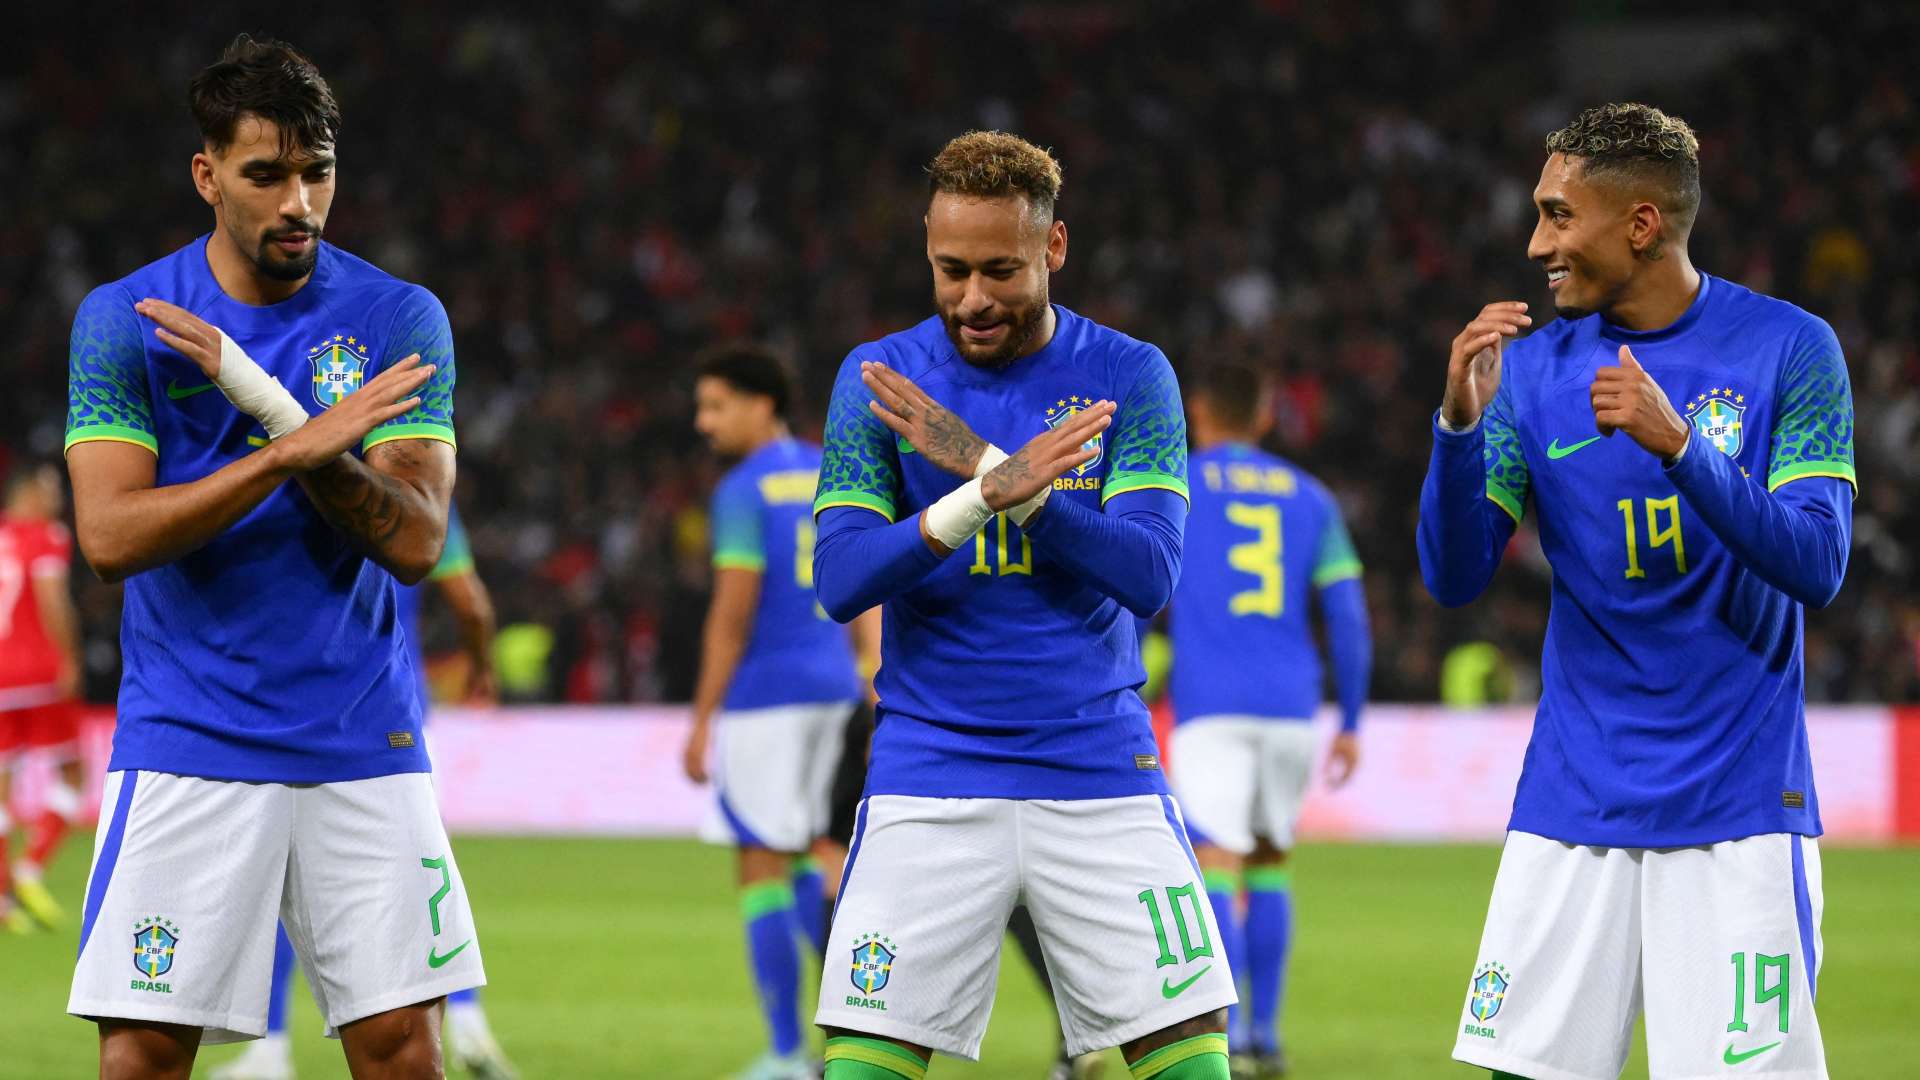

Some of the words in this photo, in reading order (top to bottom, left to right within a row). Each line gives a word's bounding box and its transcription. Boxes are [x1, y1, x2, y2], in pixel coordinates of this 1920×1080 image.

[327, 373, 348, 382] CBF
[1707, 425, 1729, 436] CBF
[1617, 494, 1688, 580] 19
[1225, 501, 1285, 618] 3
[421, 855, 451, 936] 7
[1138, 882, 1214, 969] 10
[146, 947, 163, 955] CBF
[863, 962, 880, 971] CBF
[130, 980, 173, 994] BRASIL
[1727, 952, 1790, 1034] 19
[1481, 991, 1495, 999] CBF
[845, 995, 888, 1011] BRASIL
[1464, 1024, 1497, 1039] BRASIL
